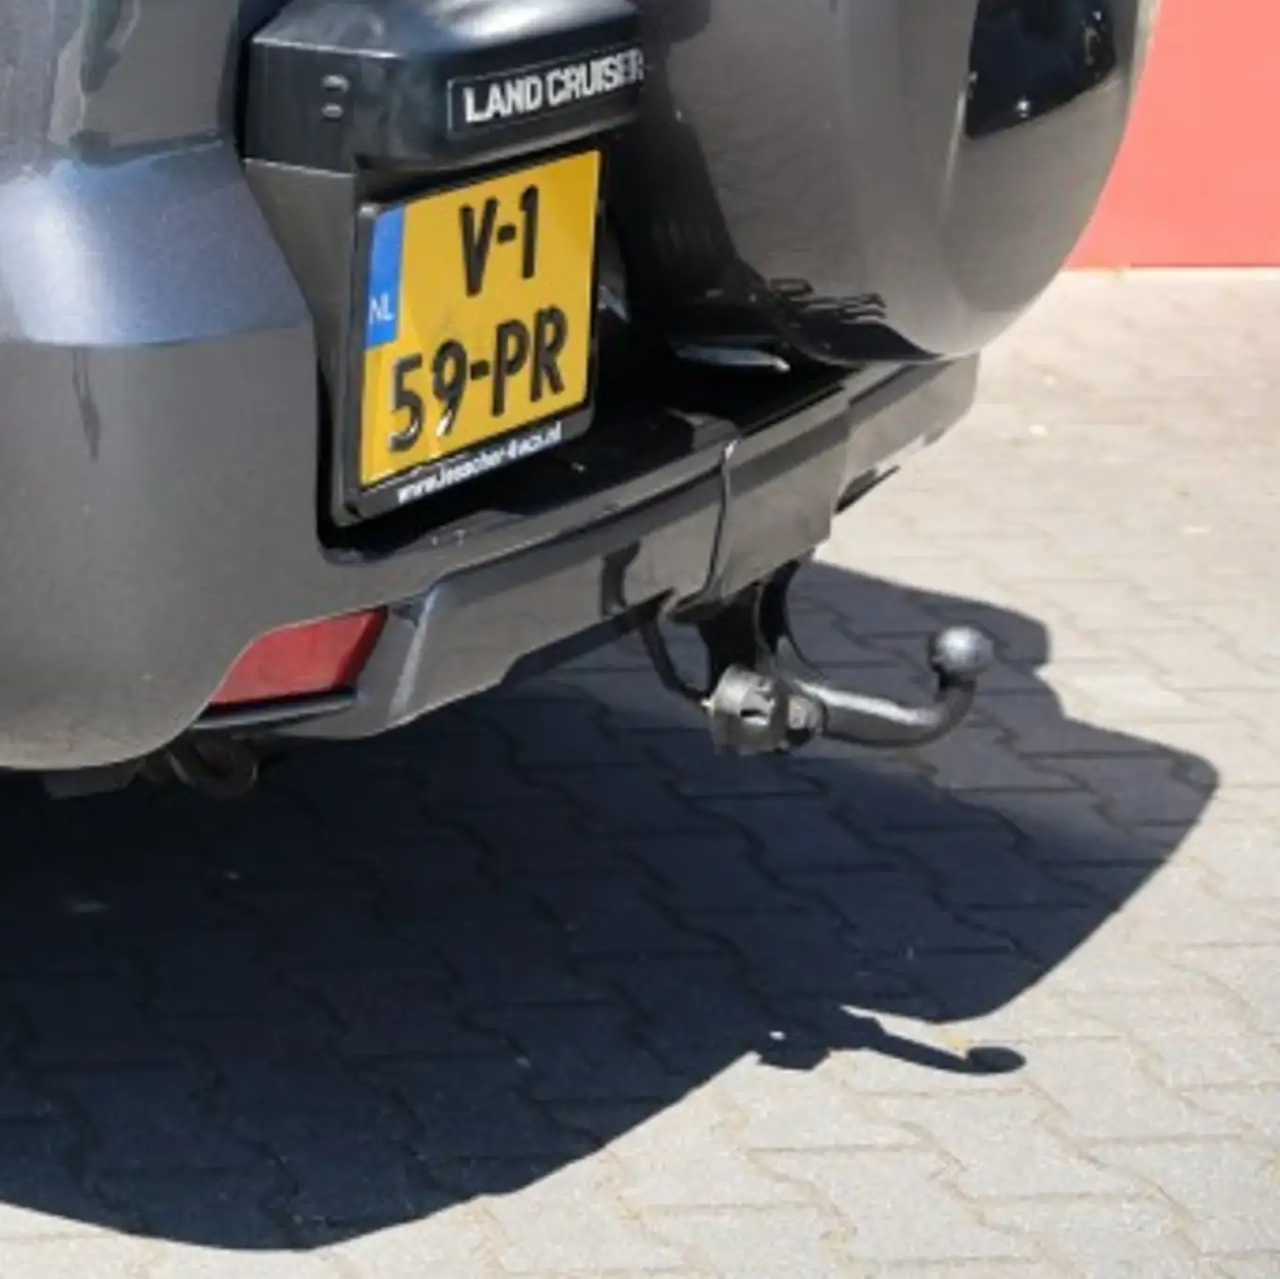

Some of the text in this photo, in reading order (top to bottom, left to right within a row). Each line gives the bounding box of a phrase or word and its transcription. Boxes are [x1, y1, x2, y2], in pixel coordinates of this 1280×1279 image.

[462, 48, 644, 123] LAND CRUISER
[458, 184, 539, 297] V-1
[368, 293, 396, 327] NL
[387, 303, 569, 453] 59-PR
